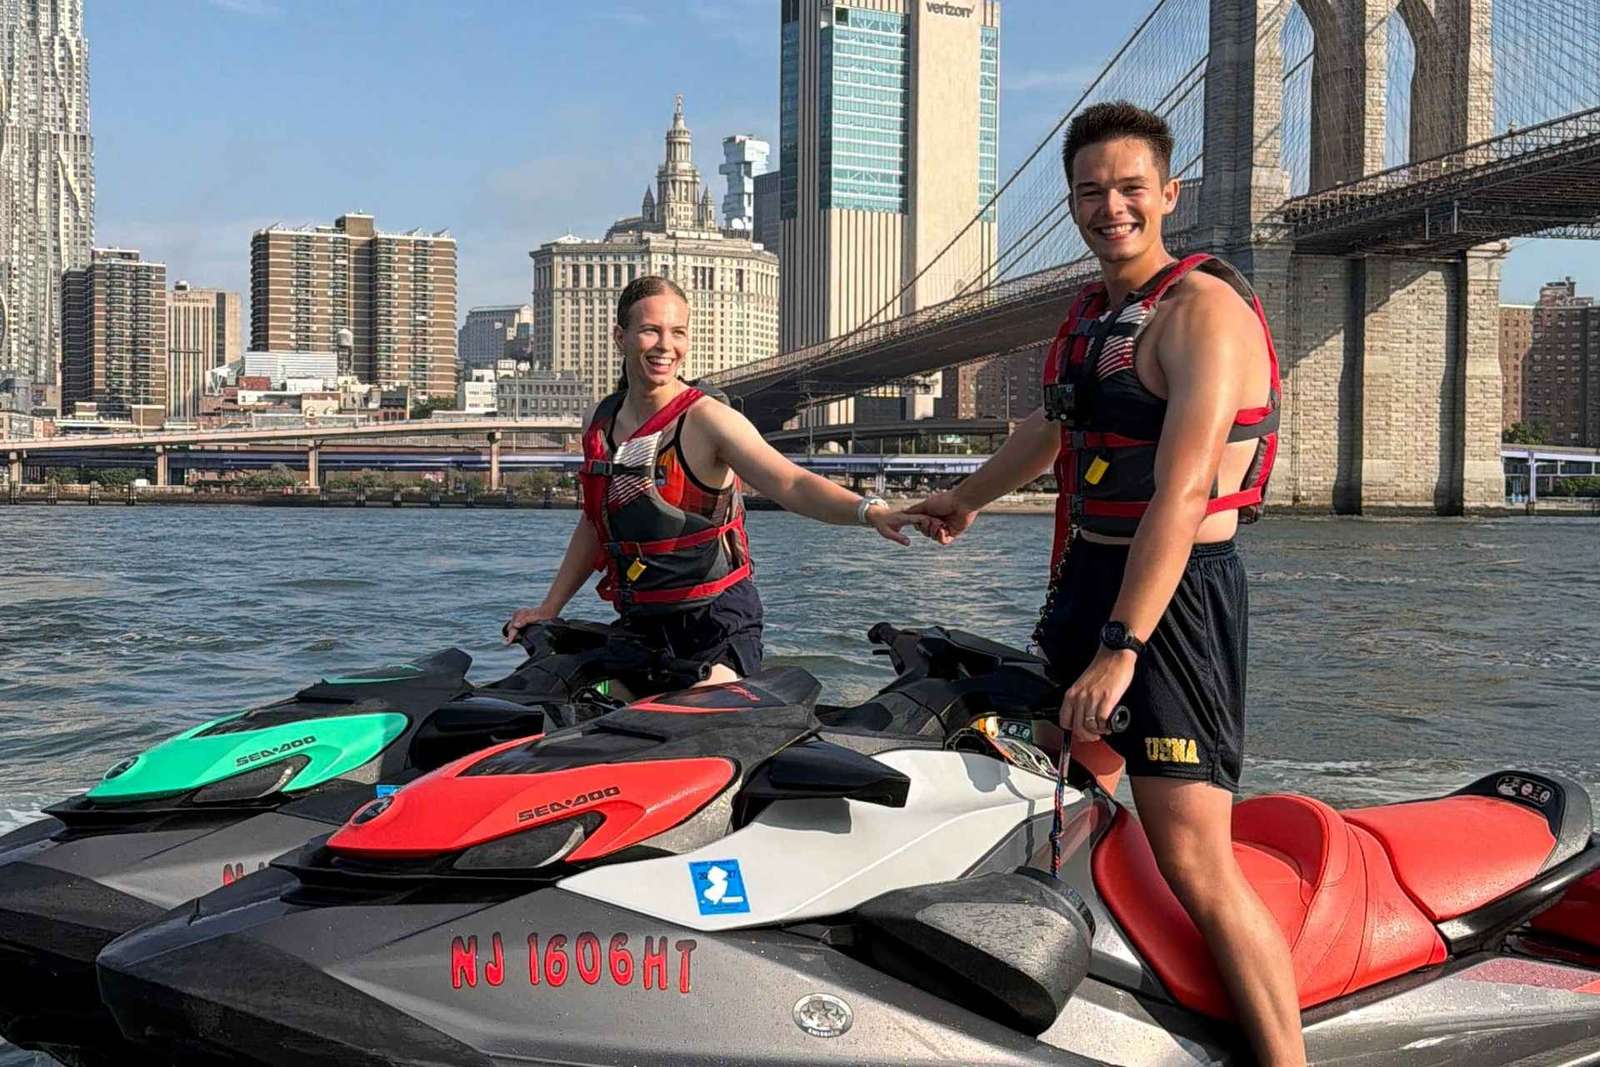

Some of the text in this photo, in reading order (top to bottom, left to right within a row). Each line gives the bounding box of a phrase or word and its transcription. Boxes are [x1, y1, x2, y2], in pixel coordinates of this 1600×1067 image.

[926, 1, 971, 18] verizon
[1144, 737, 1200, 764] USNA
[452, 931, 505, 989] NJ
